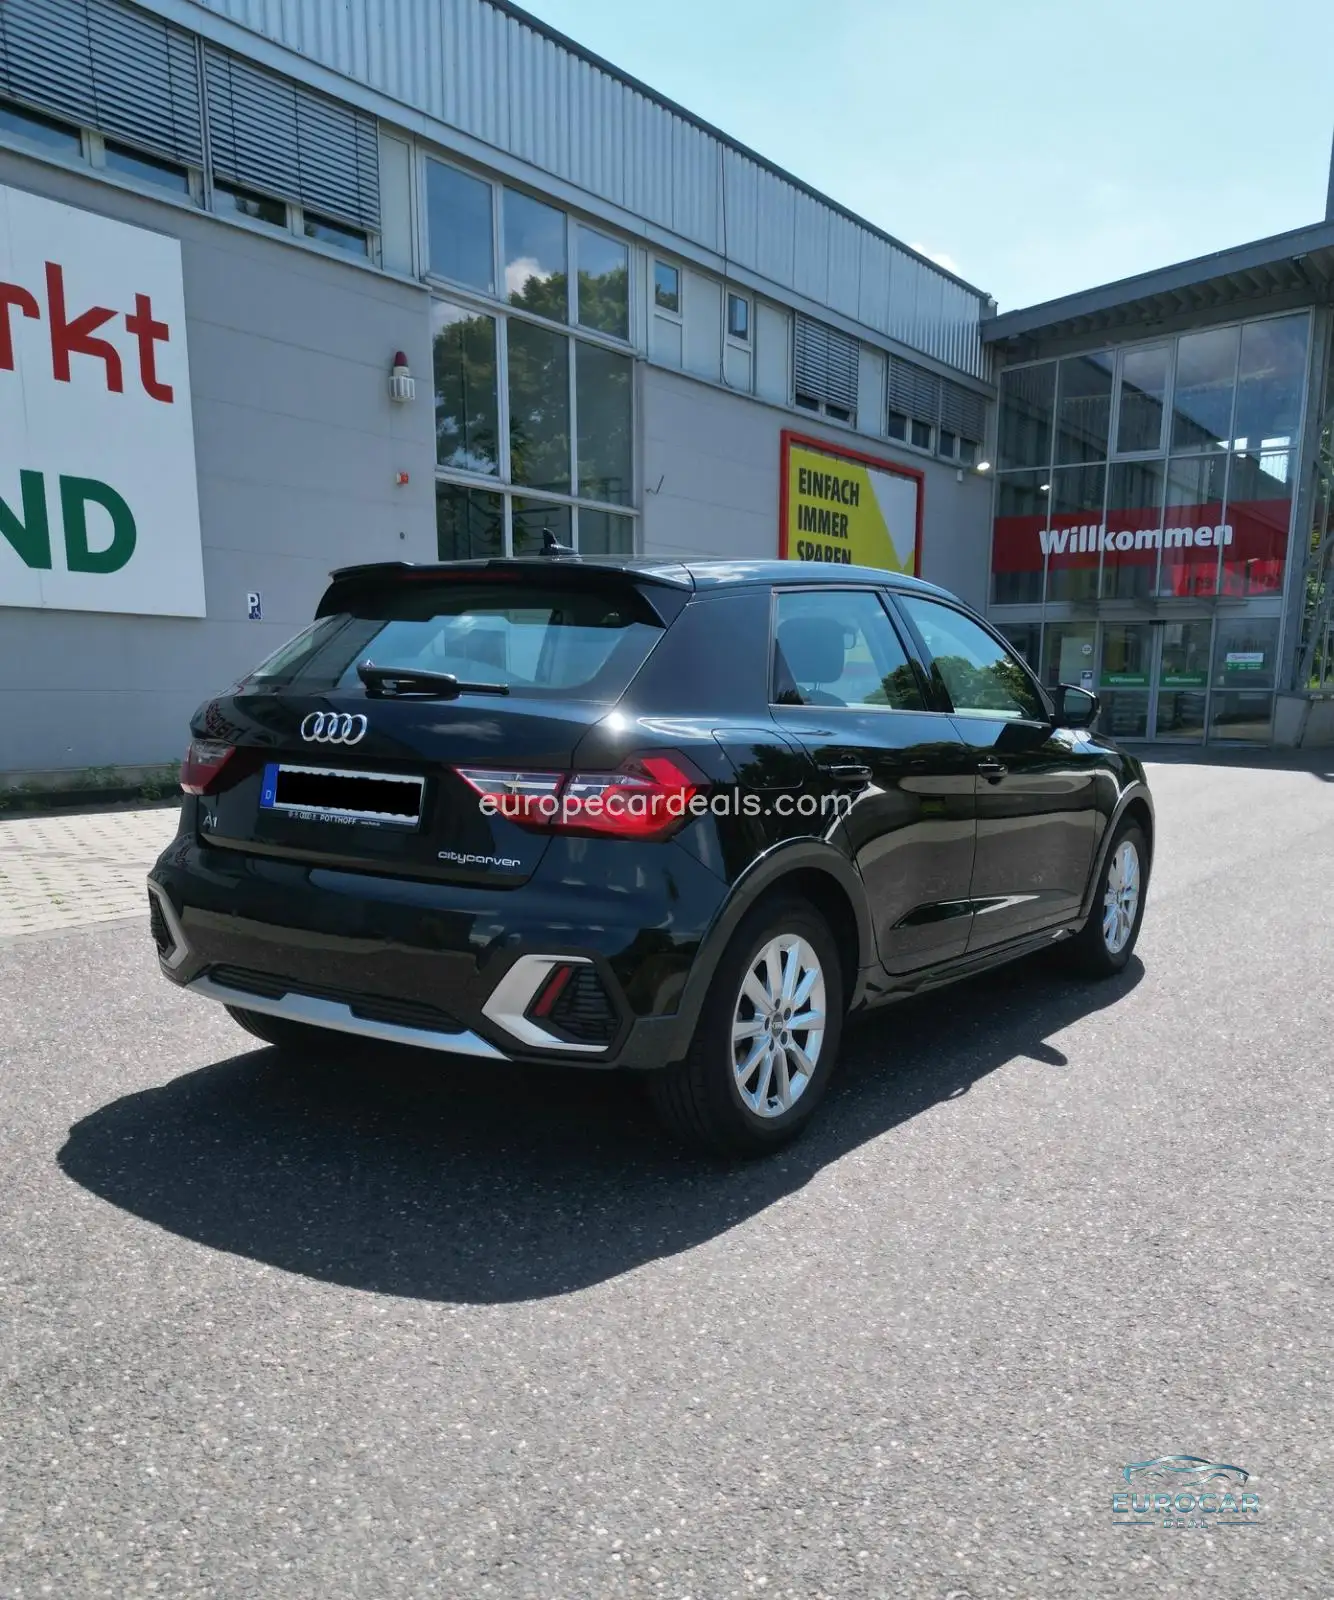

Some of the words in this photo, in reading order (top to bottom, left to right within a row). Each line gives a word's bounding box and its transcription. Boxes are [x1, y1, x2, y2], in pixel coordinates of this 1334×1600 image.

[0, 261, 174, 404] rkt
[798, 467, 860, 507] EINFACH
[797, 504, 849, 539] IMMER
[1039, 524, 1234, 555] Willkommen
[796, 540, 852, 565] SPAREN
[247, 593, 259, 614] P
[265, 790, 272, 800] D
[202, 811, 218, 828] A1
[319, 813, 357, 825] POTTHOFF
[438, 851, 521, 867] citycarver
